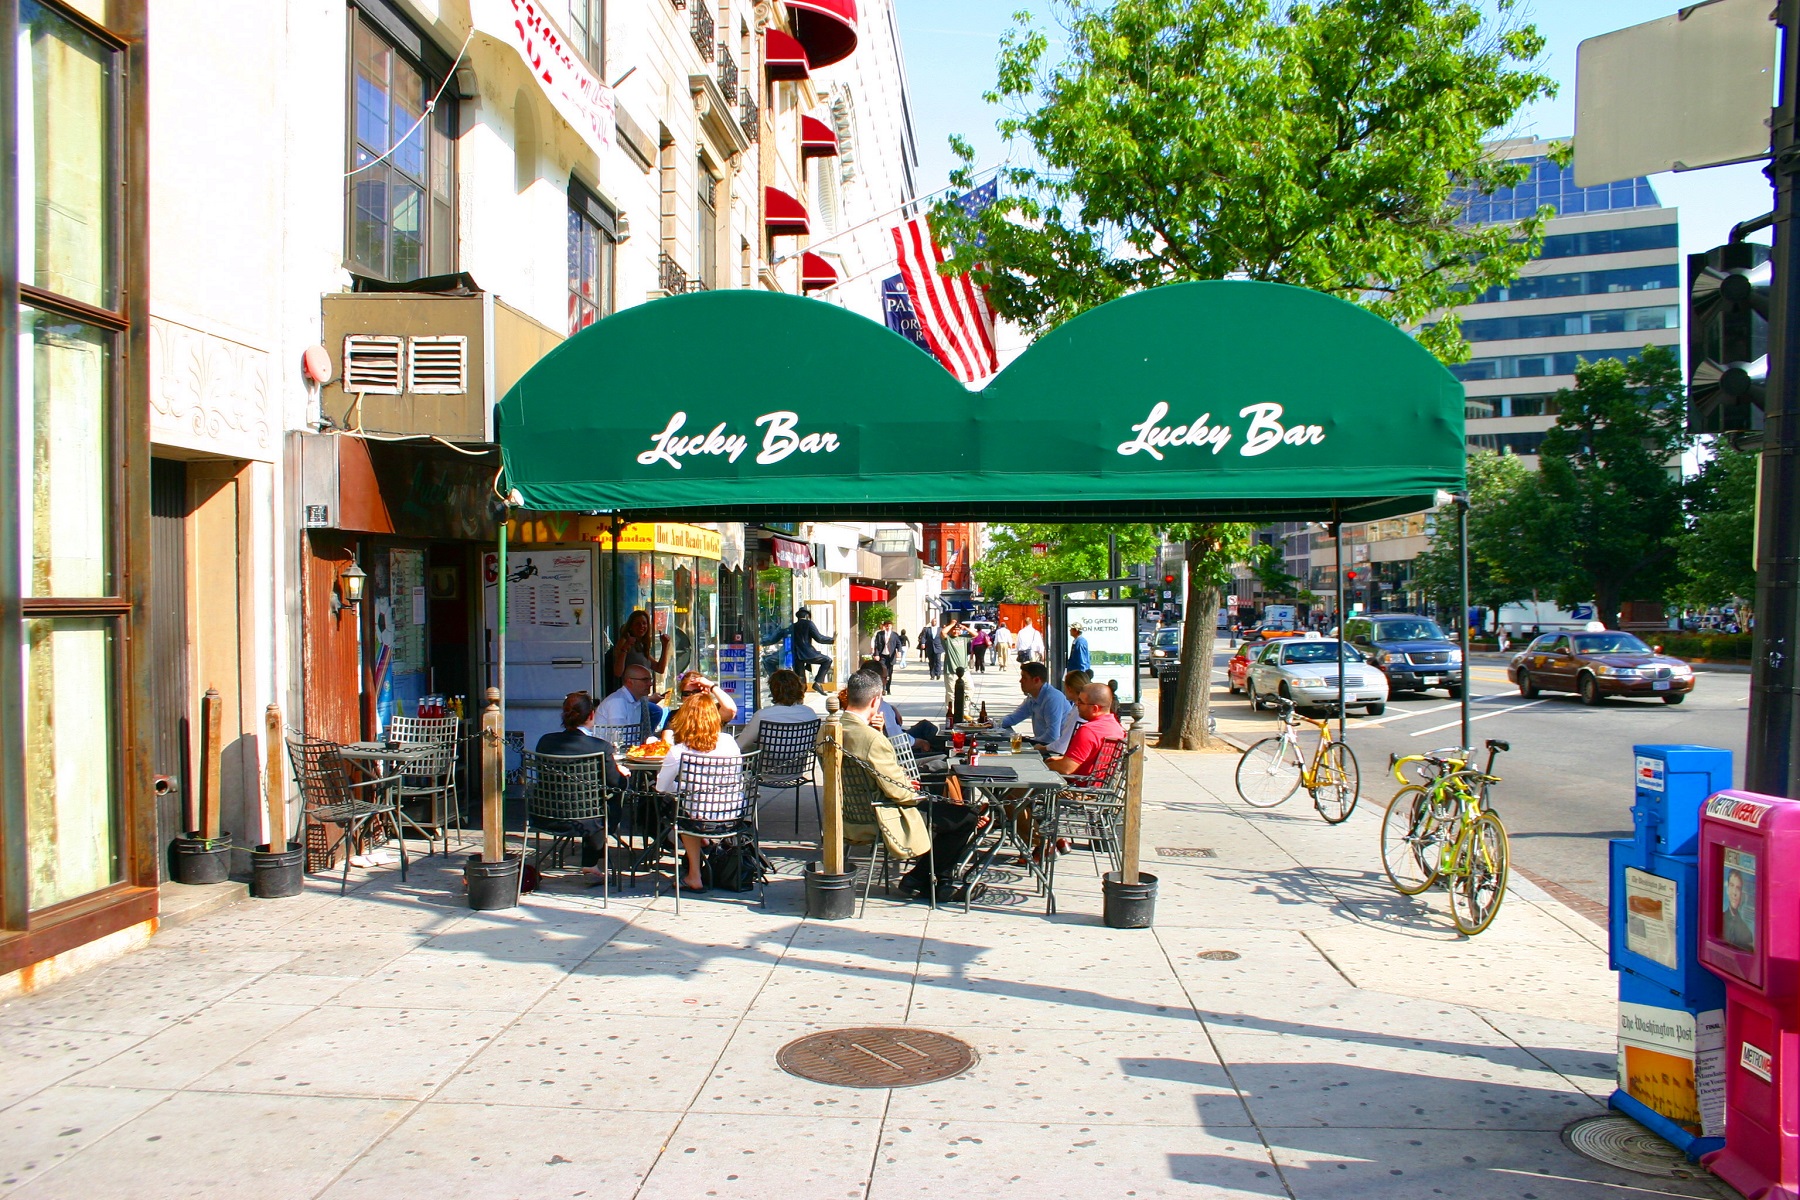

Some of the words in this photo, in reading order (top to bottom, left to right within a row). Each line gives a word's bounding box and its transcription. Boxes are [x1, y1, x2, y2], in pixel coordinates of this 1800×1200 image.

[637, 412, 747, 469] Lucky
[756, 411, 840, 464] Bar
[1117, 402, 1231, 460] Lucky
[1240, 403, 1325, 456] Bar
[656, 525, 669, 543] Hot
[671, 529, 684, 546] And
[685, 531, 702, 554] Ready
[1621, 1014, 1634, 1031] The
[1634, 1014, 1675, 1039] Washington
[1676, 1024, 1693, 1043] Post
[1705, 1022, 1721, 1031] FINAL
